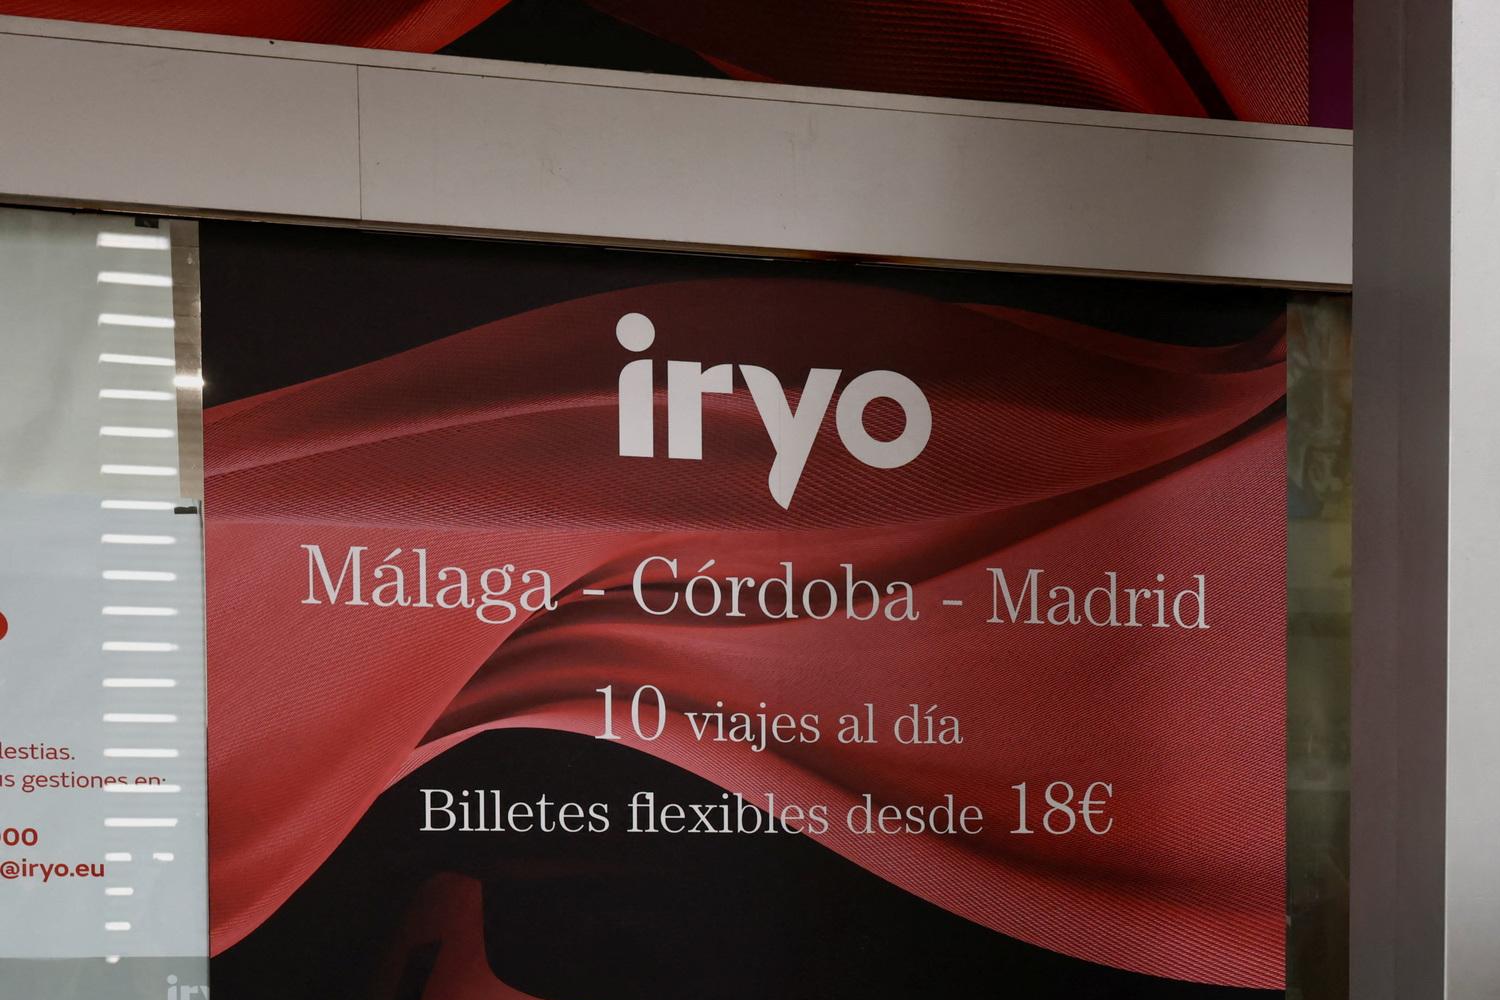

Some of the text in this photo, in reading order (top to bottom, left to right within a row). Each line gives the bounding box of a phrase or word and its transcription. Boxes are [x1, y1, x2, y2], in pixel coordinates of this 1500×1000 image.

[616, 313, 932, 510] iryo
[300, 544, 557, 625] Málaga
[632, 555, 919, 622] Córdoba
[986, 567, 1211, 630] Madrid
[595, 685, 963, 753] 10 viajes al día
[22, 772, 128, 793] gestiones
[419, 781, 1114, 836] Billetes flexibles desde 18€
[0, 828, 38, 846] 00
[0, 858, 105, 882] @iryo.eu
